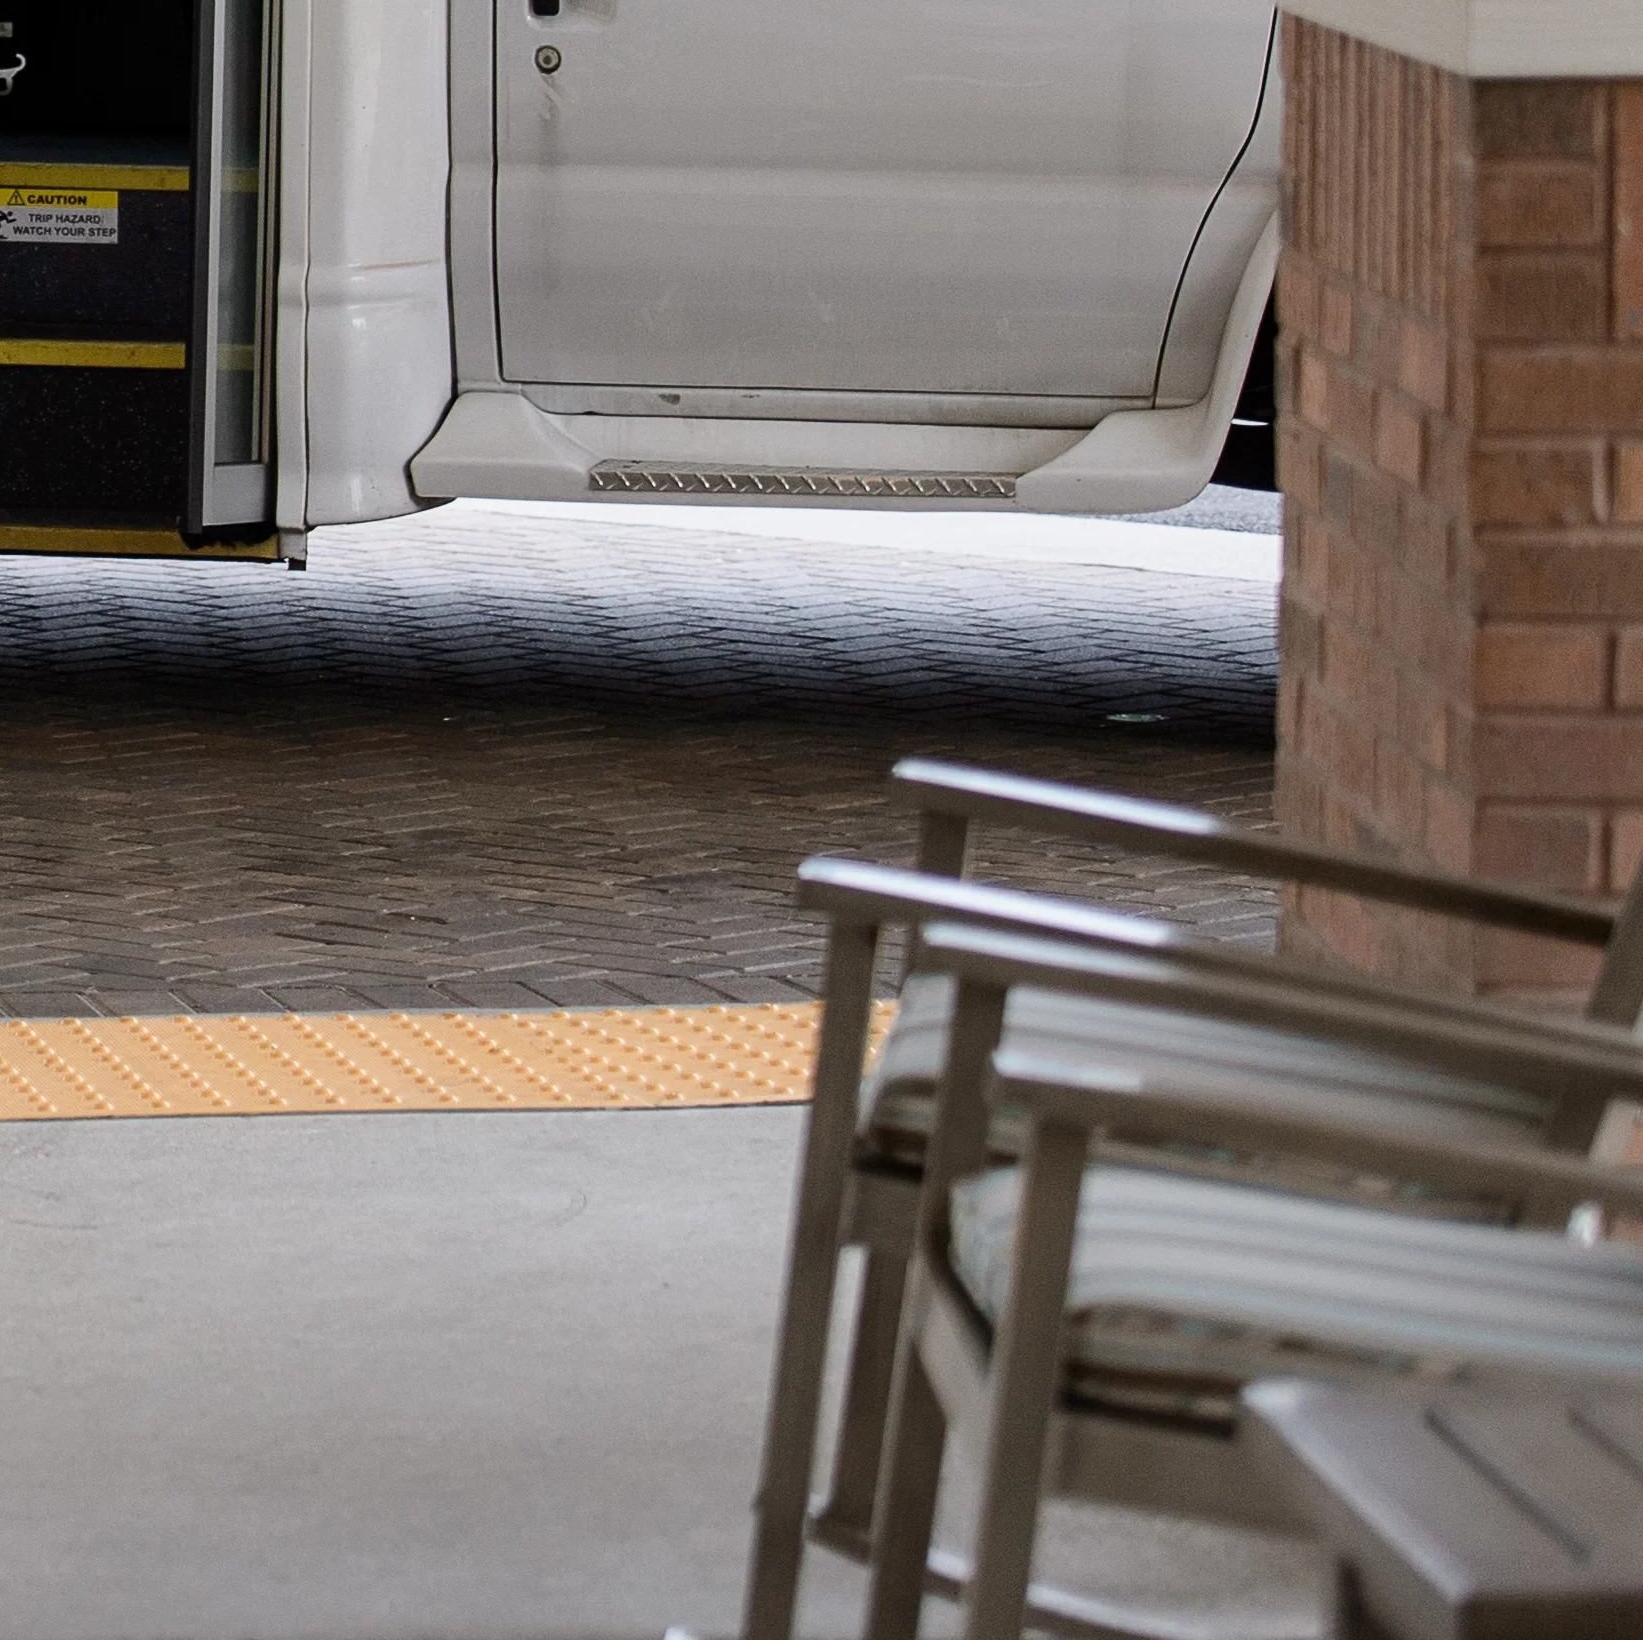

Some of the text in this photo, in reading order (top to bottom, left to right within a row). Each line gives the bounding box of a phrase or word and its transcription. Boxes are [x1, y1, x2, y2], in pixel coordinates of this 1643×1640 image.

[27, 194, 87, 205] CAUTION
[28, 213, 52, 223] TRIP
[13, 226, 116, 238] WATCH YOUR STEP
